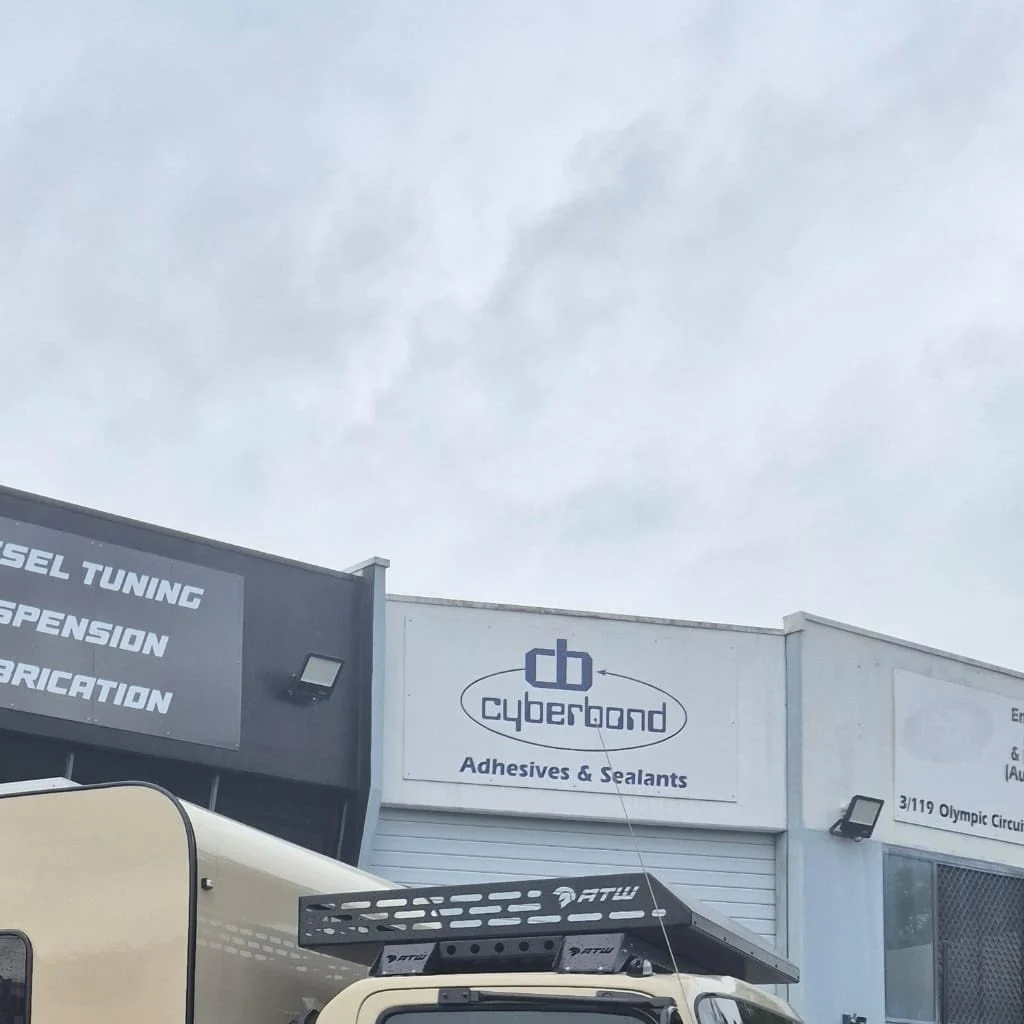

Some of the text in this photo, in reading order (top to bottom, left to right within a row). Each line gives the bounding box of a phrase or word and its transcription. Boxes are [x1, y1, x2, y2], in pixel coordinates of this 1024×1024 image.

[81, 560, 205, 610] TUNING
[481, 691, 667, 733] cyberbond
[459, 756, 688, 789] Adhesives & Sealants
[899, 795, 1024, 833] 3/119 Olympic Circui
[577, 885, 640, 903] ATW
[580, 946, 615, 955] ATW
